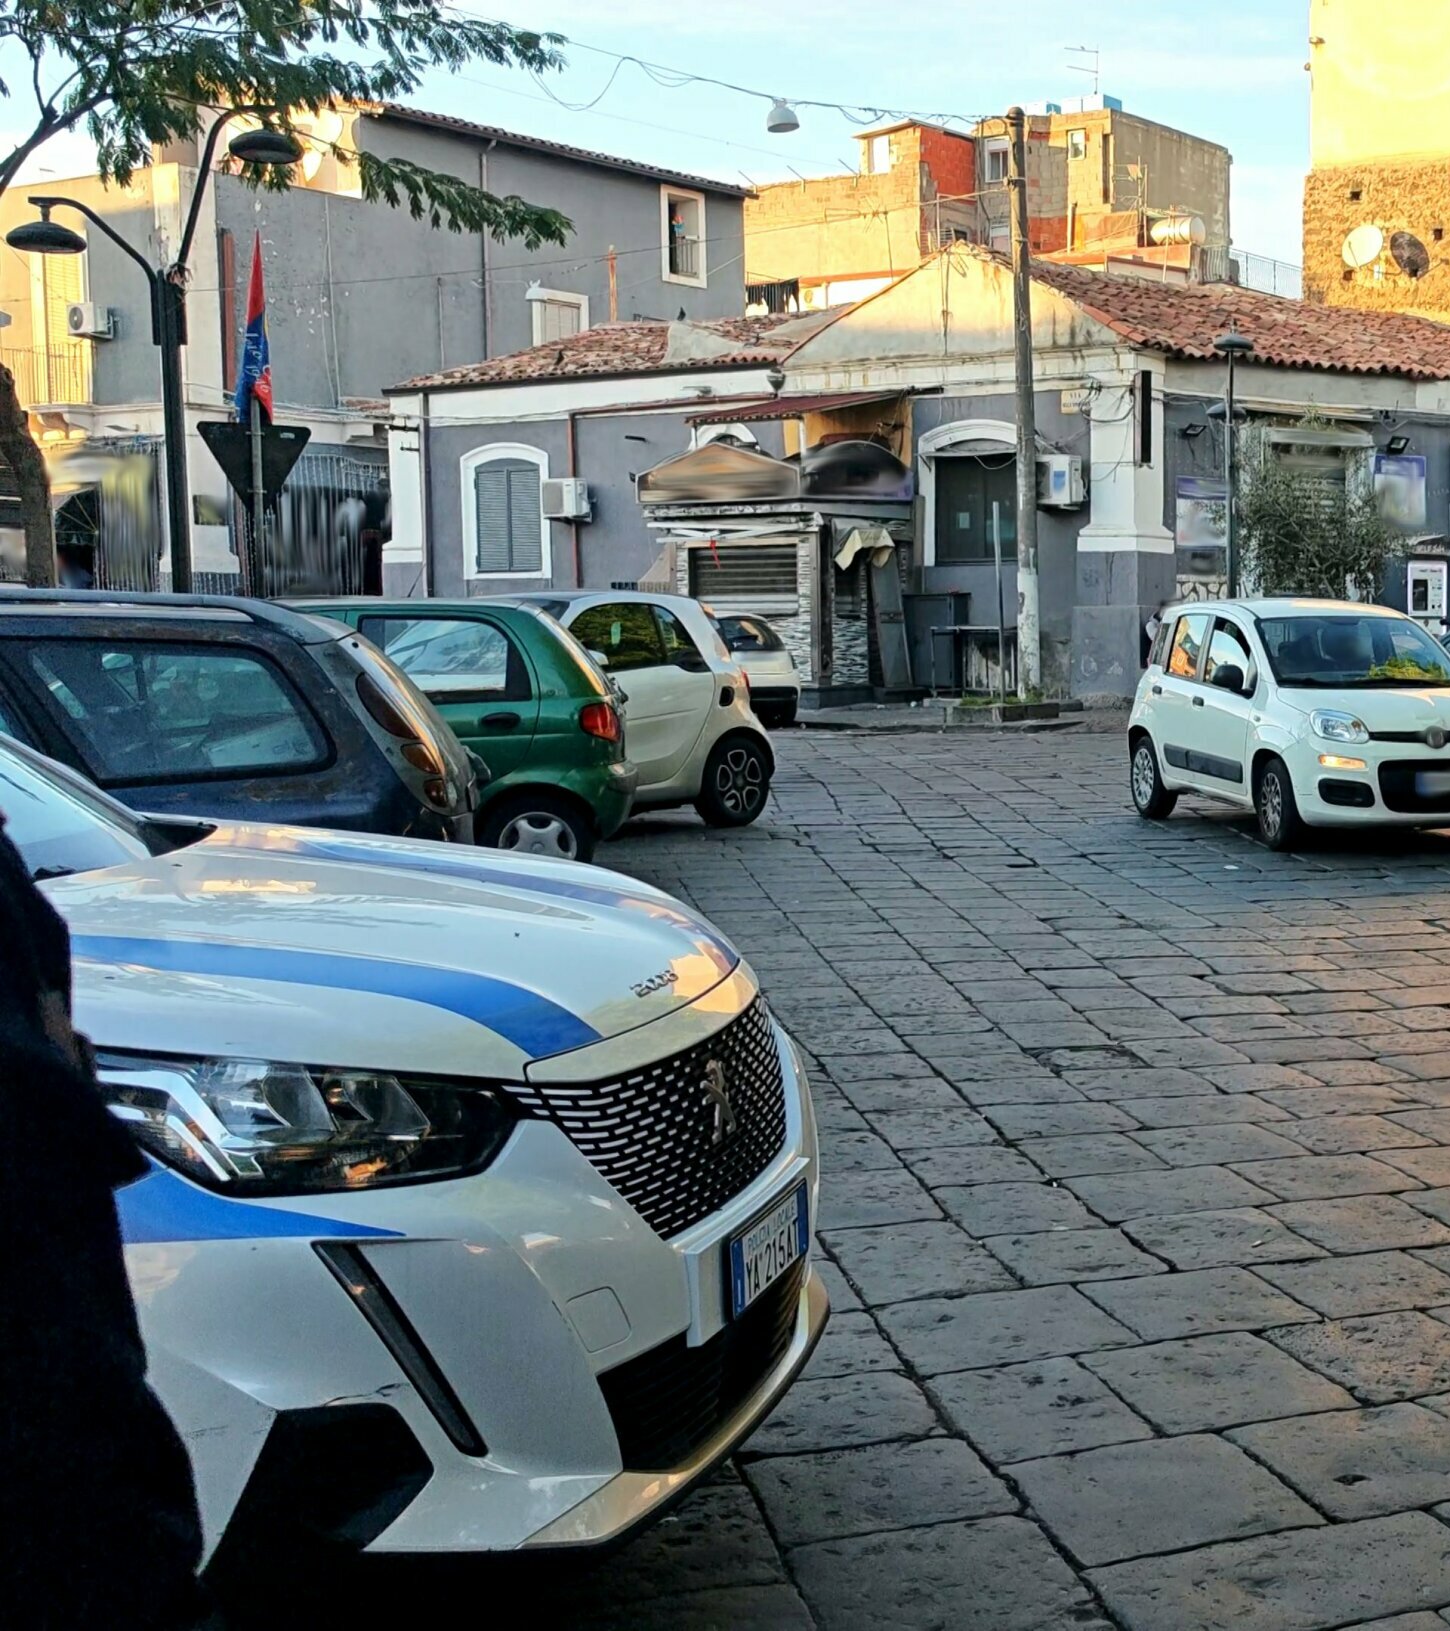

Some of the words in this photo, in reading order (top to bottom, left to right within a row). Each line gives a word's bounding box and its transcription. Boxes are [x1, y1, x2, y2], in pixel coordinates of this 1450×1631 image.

[629, 970, 679, 998] 2008
[747, 1224, 770, 1250] POLIZIA
[773, 1202, 796, 1233] LOCALE
